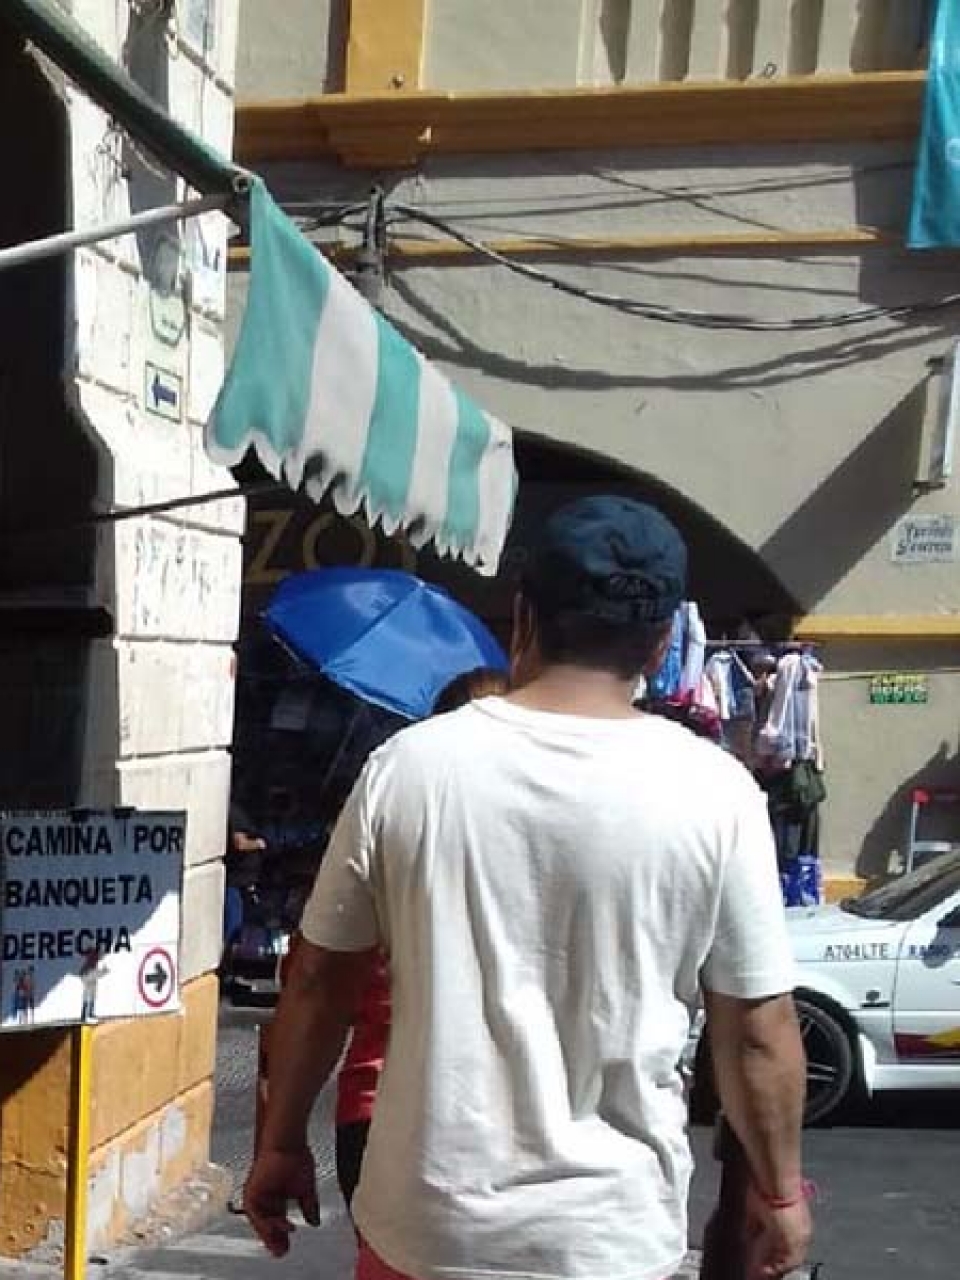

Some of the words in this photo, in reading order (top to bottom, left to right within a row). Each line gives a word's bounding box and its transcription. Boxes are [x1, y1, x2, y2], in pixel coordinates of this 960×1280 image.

[5, 825, 113, 856] CAMINA
[133, 824, 184, 853] POR
[3, 873, 153, 909] BANQUETA
[1, 925, 133, 961] DERECHA
